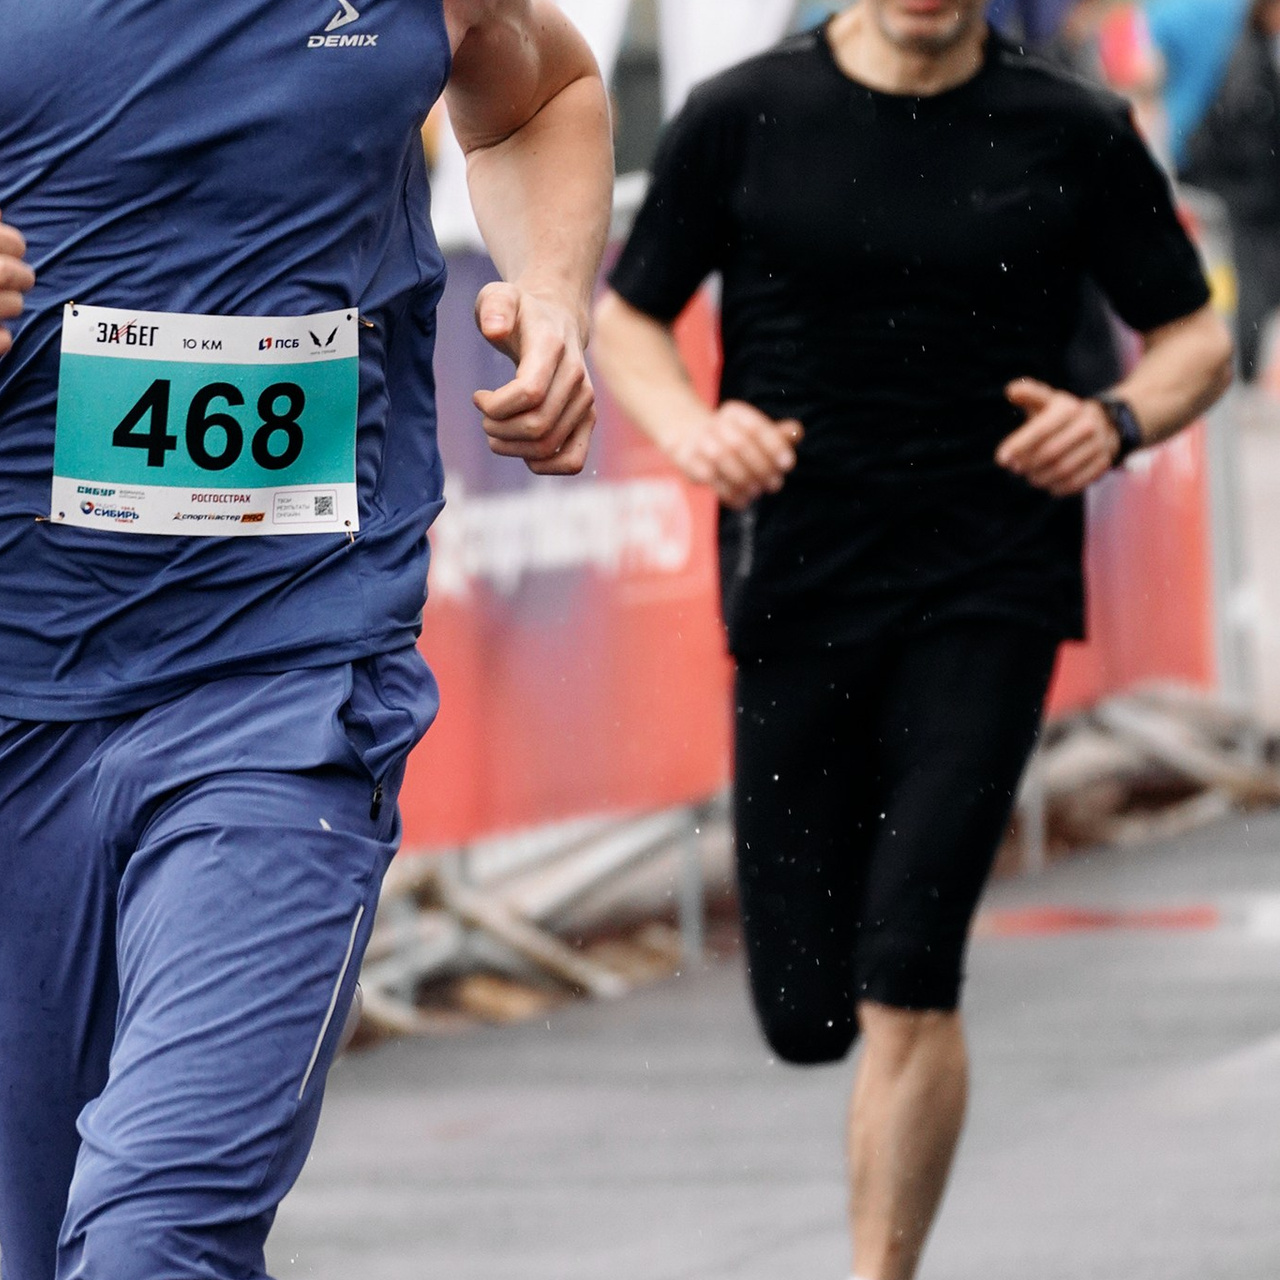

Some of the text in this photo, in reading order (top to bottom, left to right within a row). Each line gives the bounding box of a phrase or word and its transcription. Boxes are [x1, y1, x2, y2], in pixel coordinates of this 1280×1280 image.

[307, 35, 379, 48] DEMIX
[183, 339, 197, 349] 10
[275, 339, 300, 349] ПСБ
[112, 378, 306, 471] 468
[77, 486, 116, 497] СИБУР
[191, 493, 251, 503] РОСГОССТРАХ
[94, 508, 140, 520] СИБИРЬ
